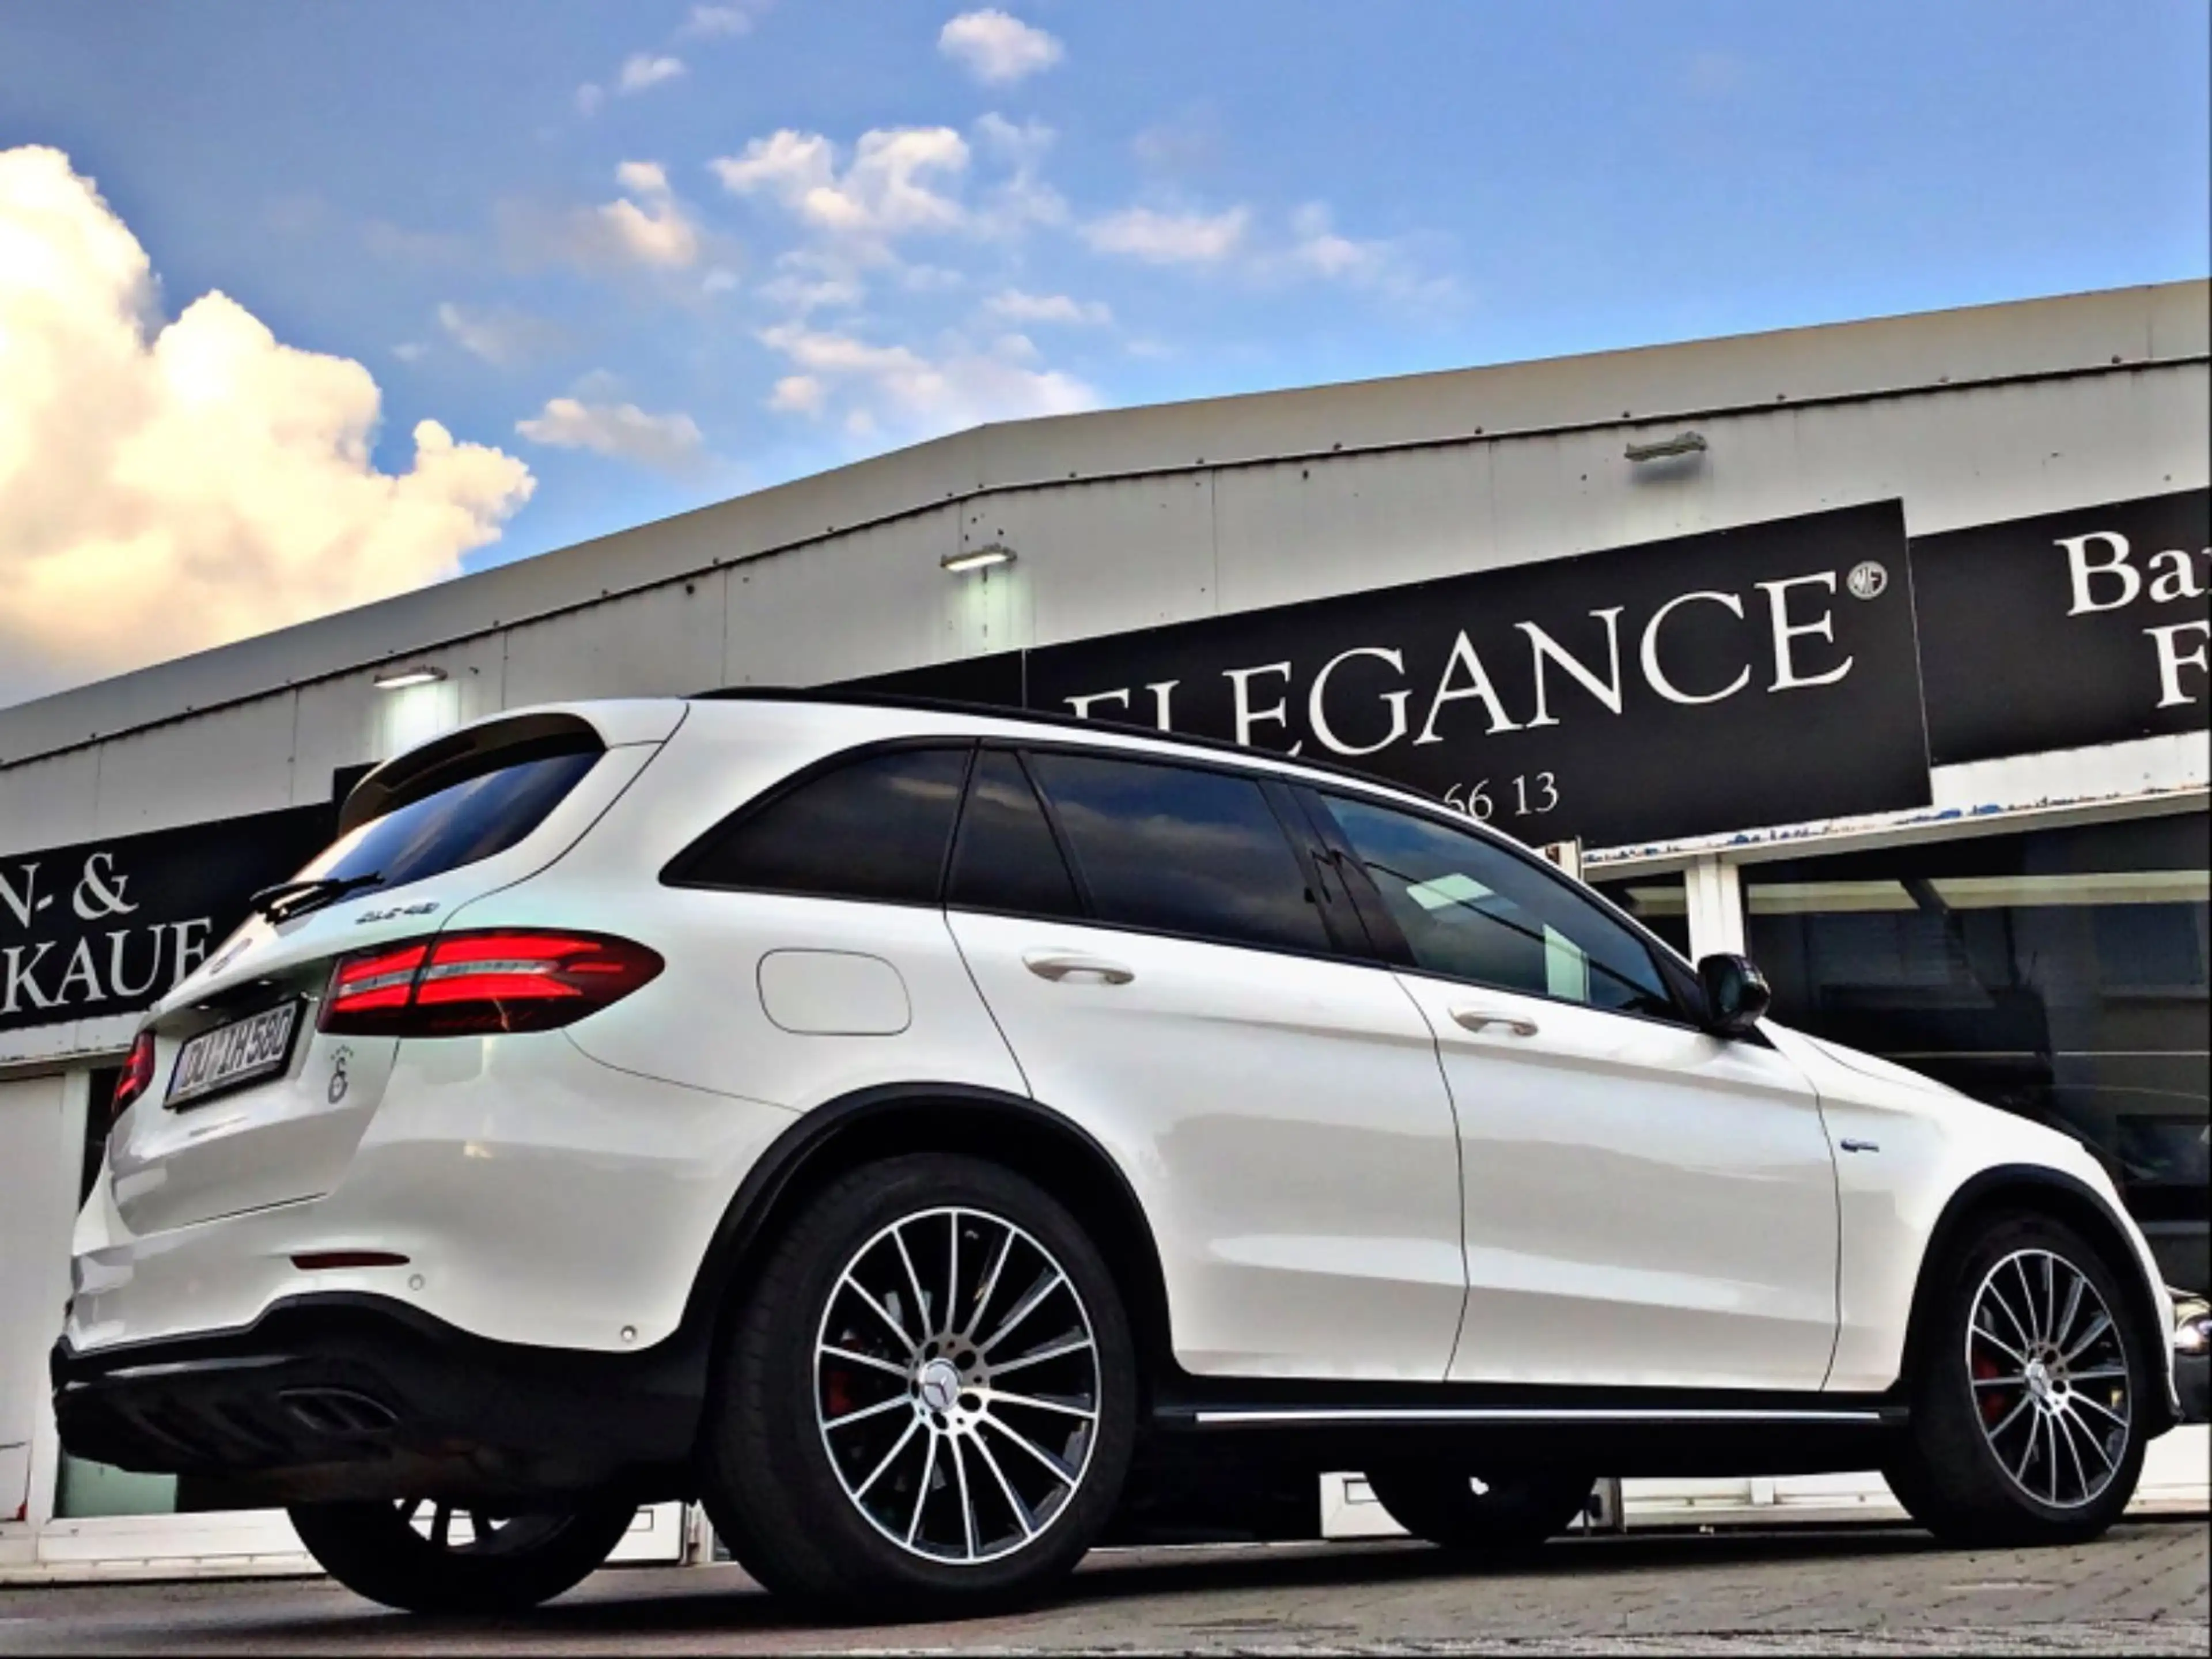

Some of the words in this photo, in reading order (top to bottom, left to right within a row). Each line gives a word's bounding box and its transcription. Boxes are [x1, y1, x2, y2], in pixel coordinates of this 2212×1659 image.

[2052, 531, 2211, 616] Ba
[1443, 778, 1493, 821] 66
[1512, 771, 1559, 816] 13
[72, 853, 139, 920] &
